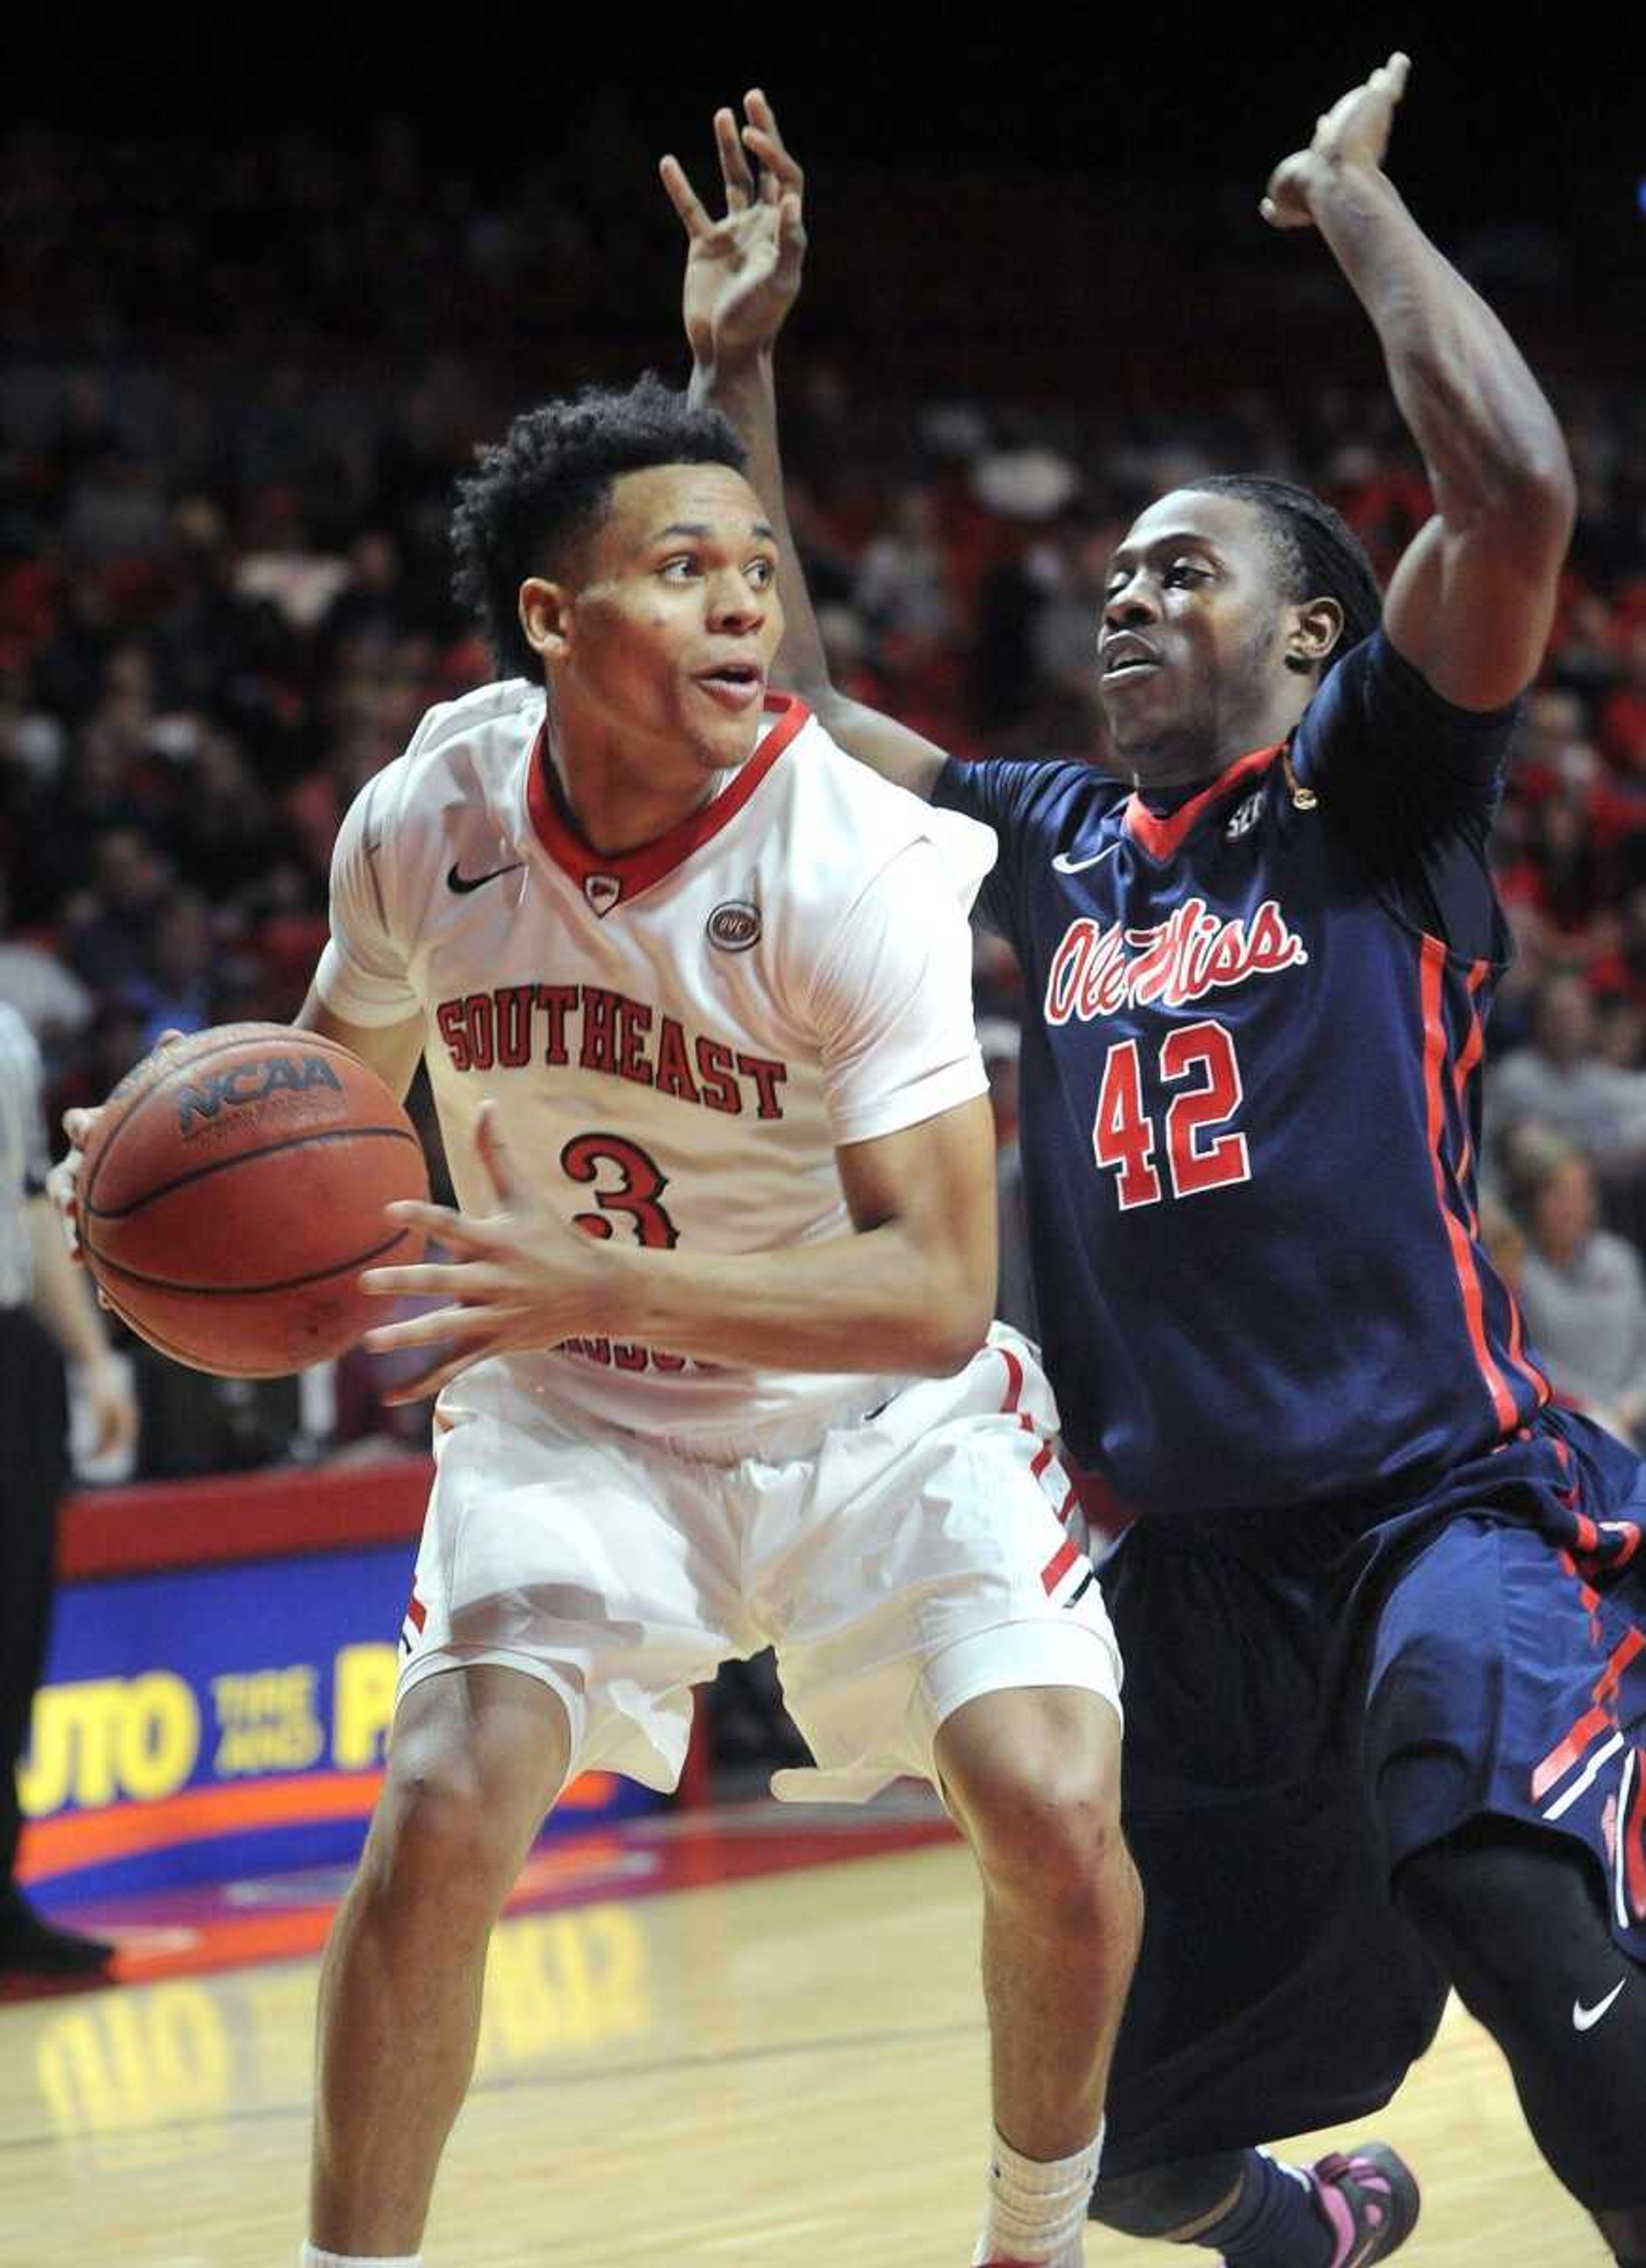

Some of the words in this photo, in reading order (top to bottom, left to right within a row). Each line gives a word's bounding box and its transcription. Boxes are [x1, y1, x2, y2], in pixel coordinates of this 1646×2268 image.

[1045, 918, 1126, 1025] Ole
[180, 1057, 342, 1135] NCAA
[436, 983, 788, 1120] SOUTHEAST
[1093, 1020, 1252, 1210] 42
[560, 1132, 682, 1250] 3
